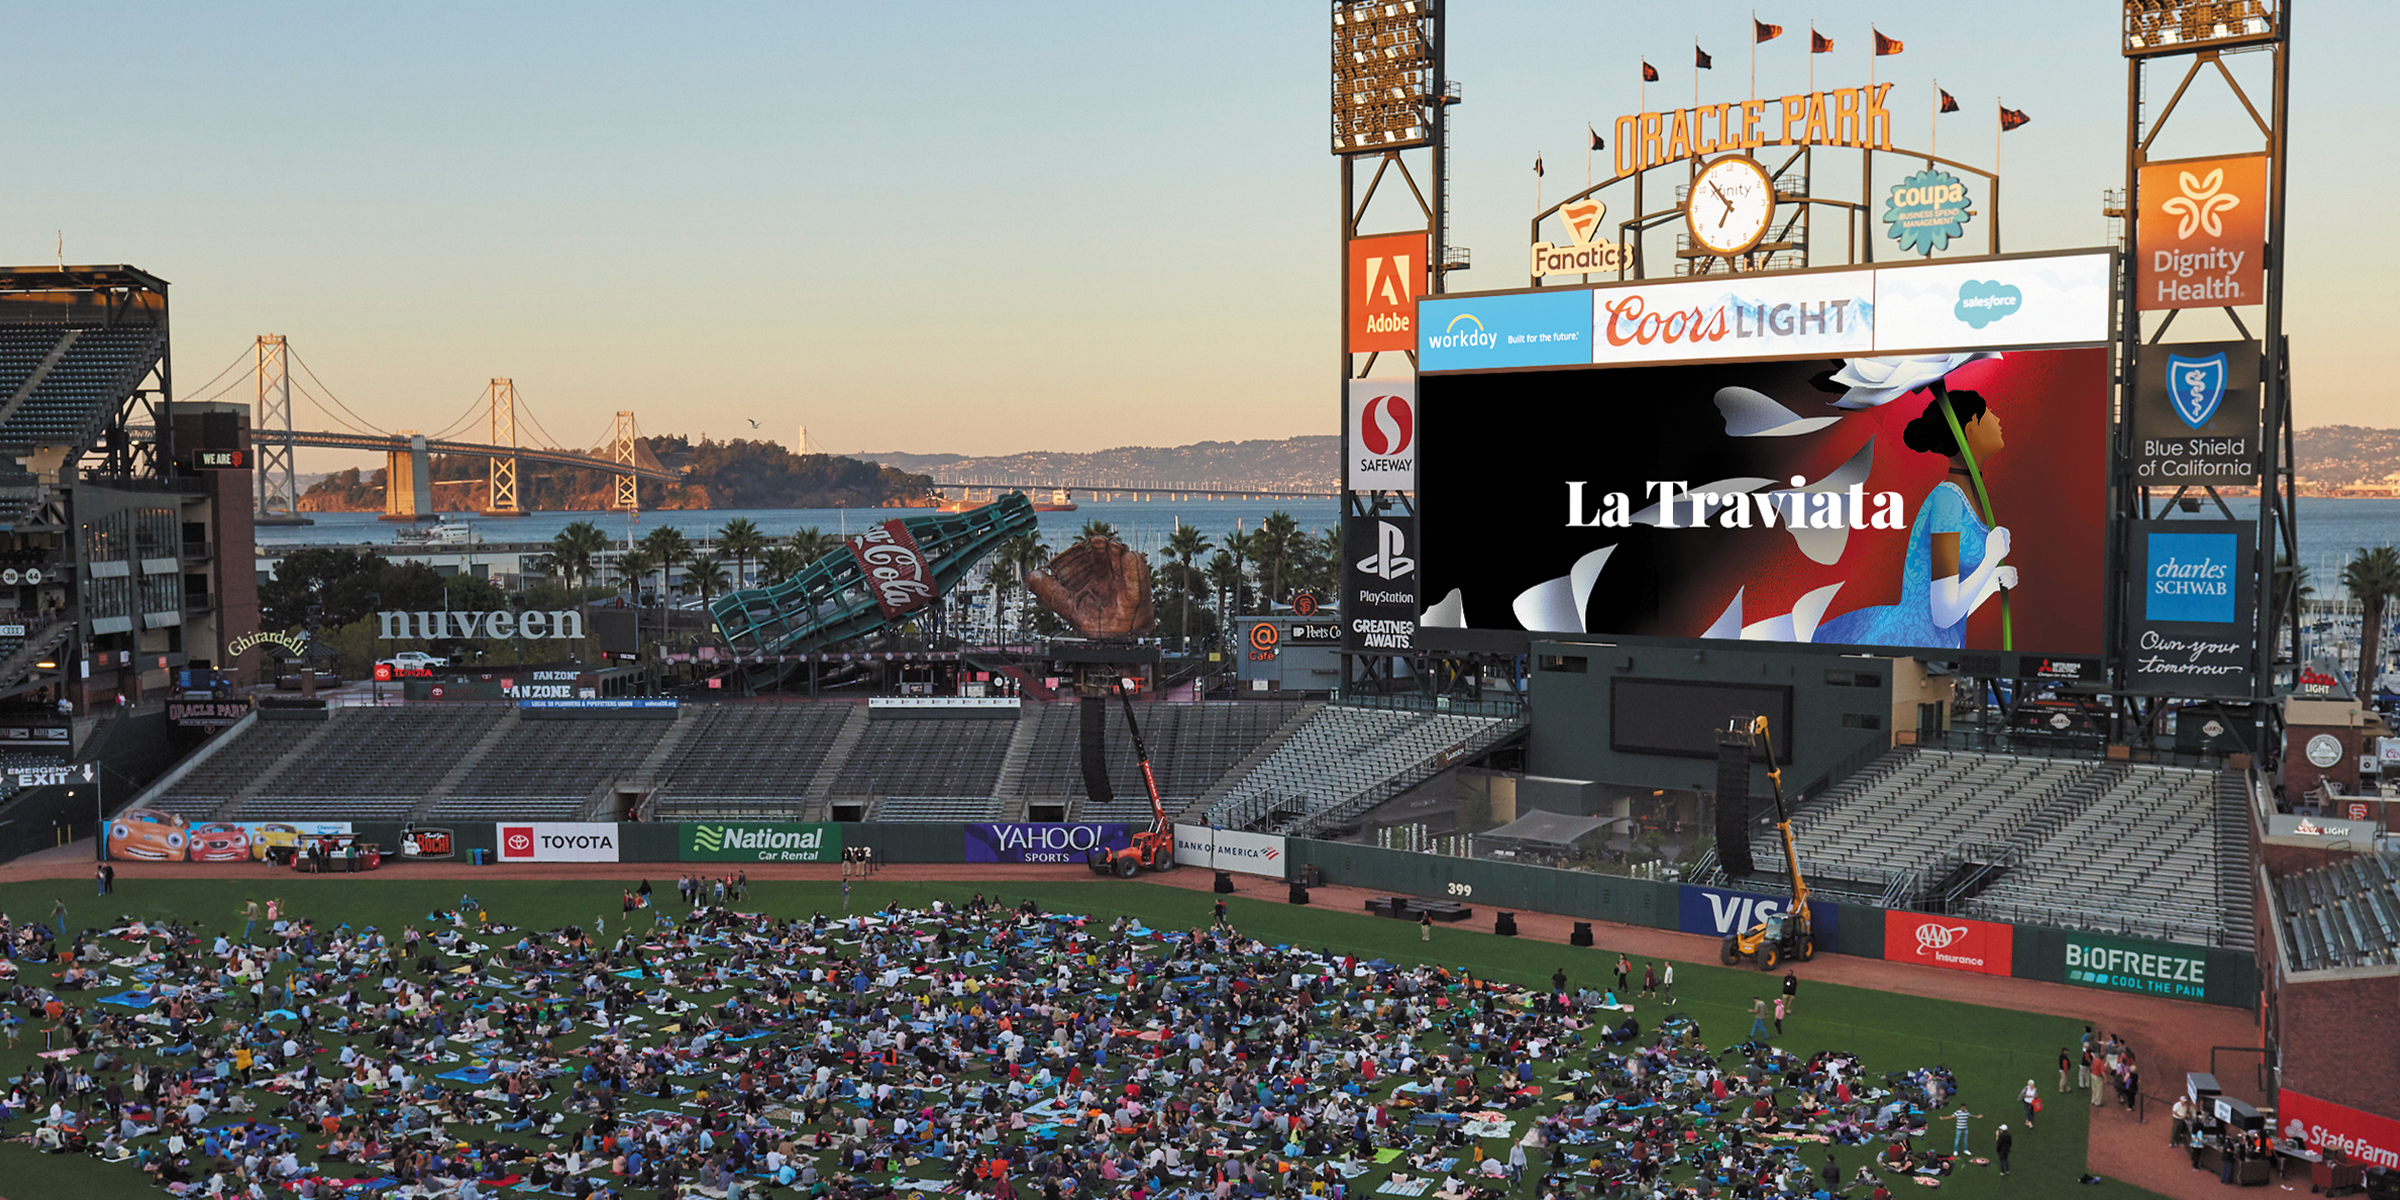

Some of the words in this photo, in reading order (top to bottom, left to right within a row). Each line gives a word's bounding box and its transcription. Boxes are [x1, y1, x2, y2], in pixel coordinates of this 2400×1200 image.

[1615, 99, 1765, 178] ORACLE
[1780, 82, 1893, 151] PARK
[1894, 183, 1963, 210] coupa
[1899, 211, 1933, 220] BUSINESS
[1934, 208, 1959, 217] SPEND
[1903, 217, 1954, 228] MANAGEMENT
[2154, 246, 2244, 277] Dignity
[2158, 275, 2240, 301] Health
[1963, 295, 2016, 309] salesforce
[1366, 312, 1409, 333] Adobe
[1605, 295, 1730, 346] Coors
[1736, 299, 1851, 338] LIGHT
[1429, 329, 1497, 349] workday
[1508, 335, 1525, 344] Built
[1527, 334, 1538, 343] for
[1539, 333, 1552, 342] the
[2145, 439, 2183, 456] Blue
[2189, 438, 2244, 456] Shield
[203, 453, 216, 465] WE
[216, 453, 232, 465] ARE
[1361, 459, 1413, 472] SAFEWAY
[2138, 460, 2157, 476] of
[2161, 459, 2251, 476] California
[1565, 480, 1632, 528] La
[1646, 475, 1907, 530] Traviata
[2155, 557, 2227, 579] charles
[28, 573, 39, 581] 44
[2155, 581, 2227, 595] SCHWAB
[1360, 590, 1414, 606] PlayStation
[378, 609, 585, 639] nuveen
[228, 629, 308, 657] Ghirardelli
[2140, 630, 2185, 650] Own
[2187, 641, 2240, 662] your
[1249, 651, 1275, 661] Café
[393, 668, 433, 677] TOYOTA
[533, 671, 552, 680] FAN
[2300, 667, 2337, 686] Coors
[2305, 684, 2330, 694] LIGHT
[169, 704, 215, 721] ORACLE
[7, 765, 78, 775] EMERGENCY
[18, 772, 69, 787] EXIT
[724, 828, 823, 849] National
[993, 825, 1102, 851] YAHOO!
[2324, 827, 2350, 836] LIGHT
[542, 836, 612, 849] TOYOTA
[1178, 840, 1203, 853] BANK
[1218, 846, 1259, 859] AMERICA
[758, 851, 781, 861] Car
[786, 851, 818, 861] Rental
[1025, 853, 1069, 862] SPORTS
[1448, 882, 1472, 897] 399
[1702, 893, 1778, 934] VIS
[1919, 926, 1950, 948] AAA
[1935, 951, 1984, 967] Insurance
[2112, 975, 2143, 991] COOL
[2148, 980, 2172, 993] THE
[2175, 983, 2205, 998] PAIN
